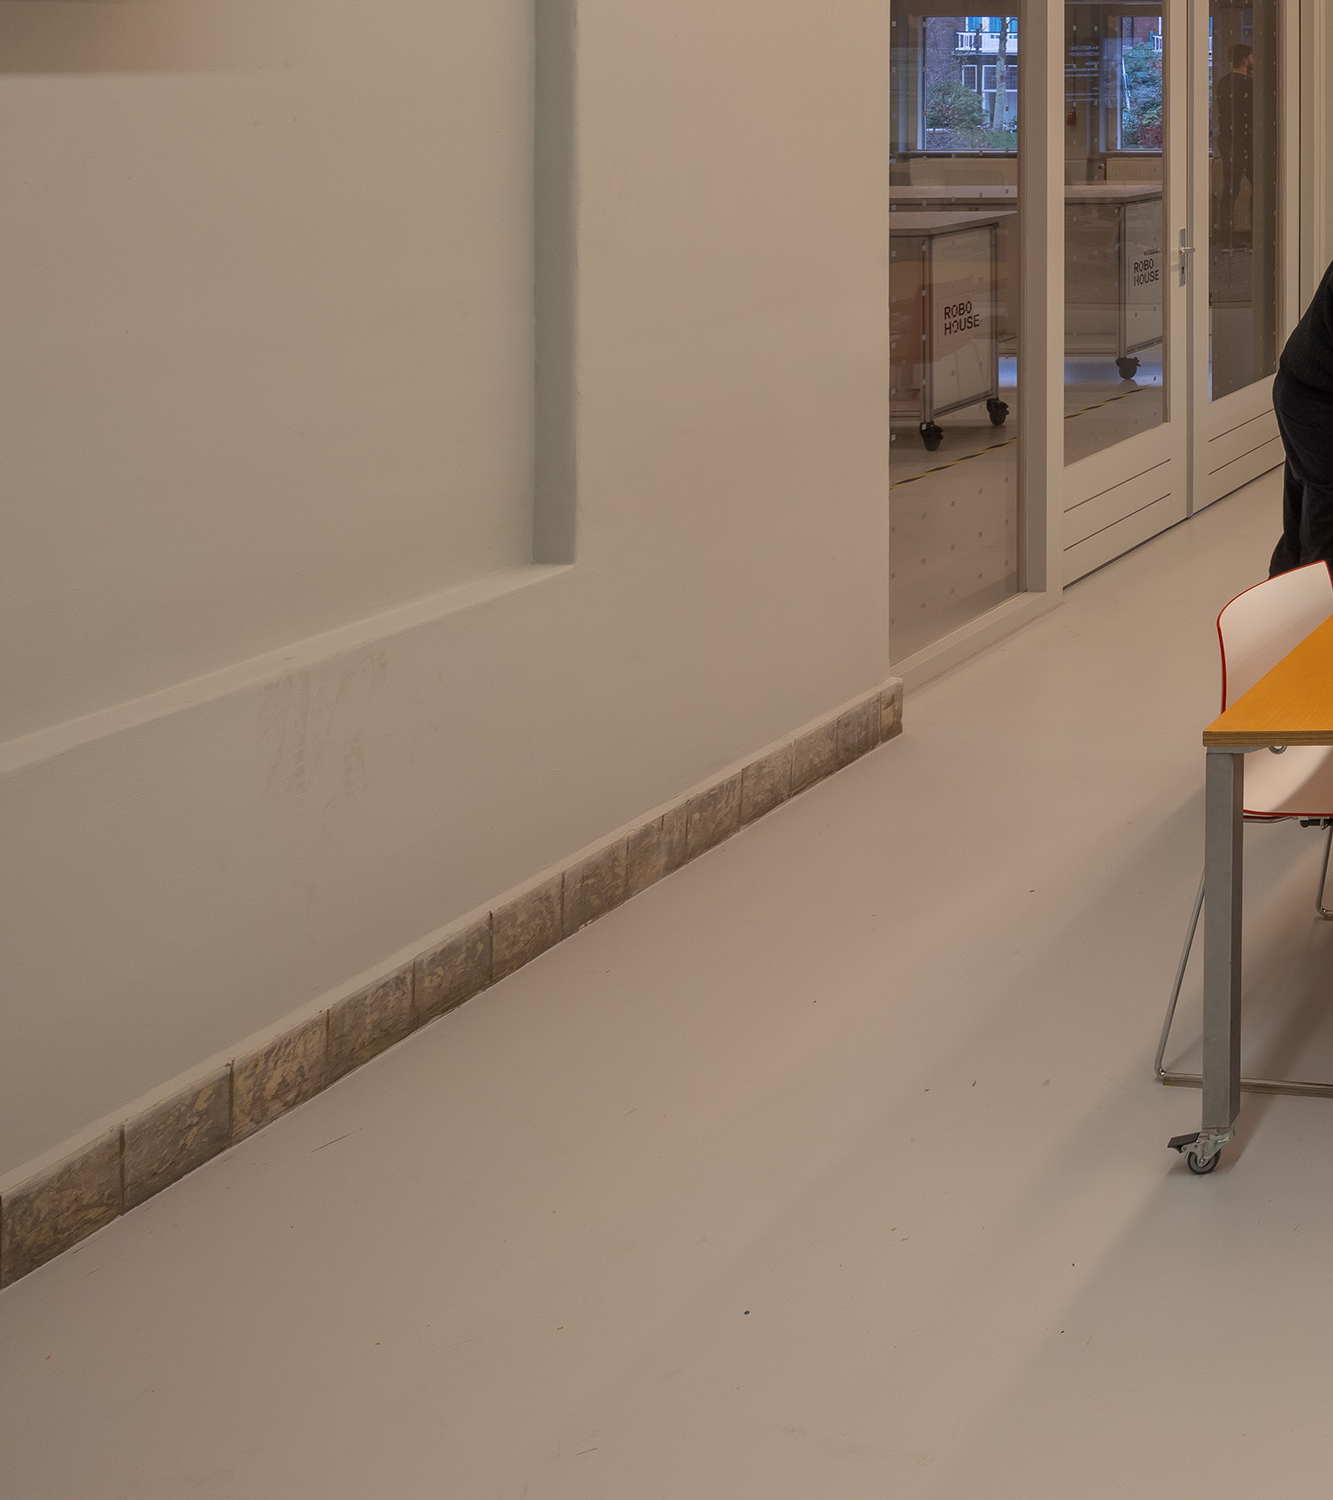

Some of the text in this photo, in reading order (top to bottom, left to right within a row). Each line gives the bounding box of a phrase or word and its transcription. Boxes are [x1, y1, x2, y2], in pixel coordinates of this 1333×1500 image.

[1133, 258, 1155, 273] ROBO
[1133, 269, 1160, 287] HOUSE
[944, 301, 973, 320] ROBO
[944, 314, 980, 336] HOUSE
